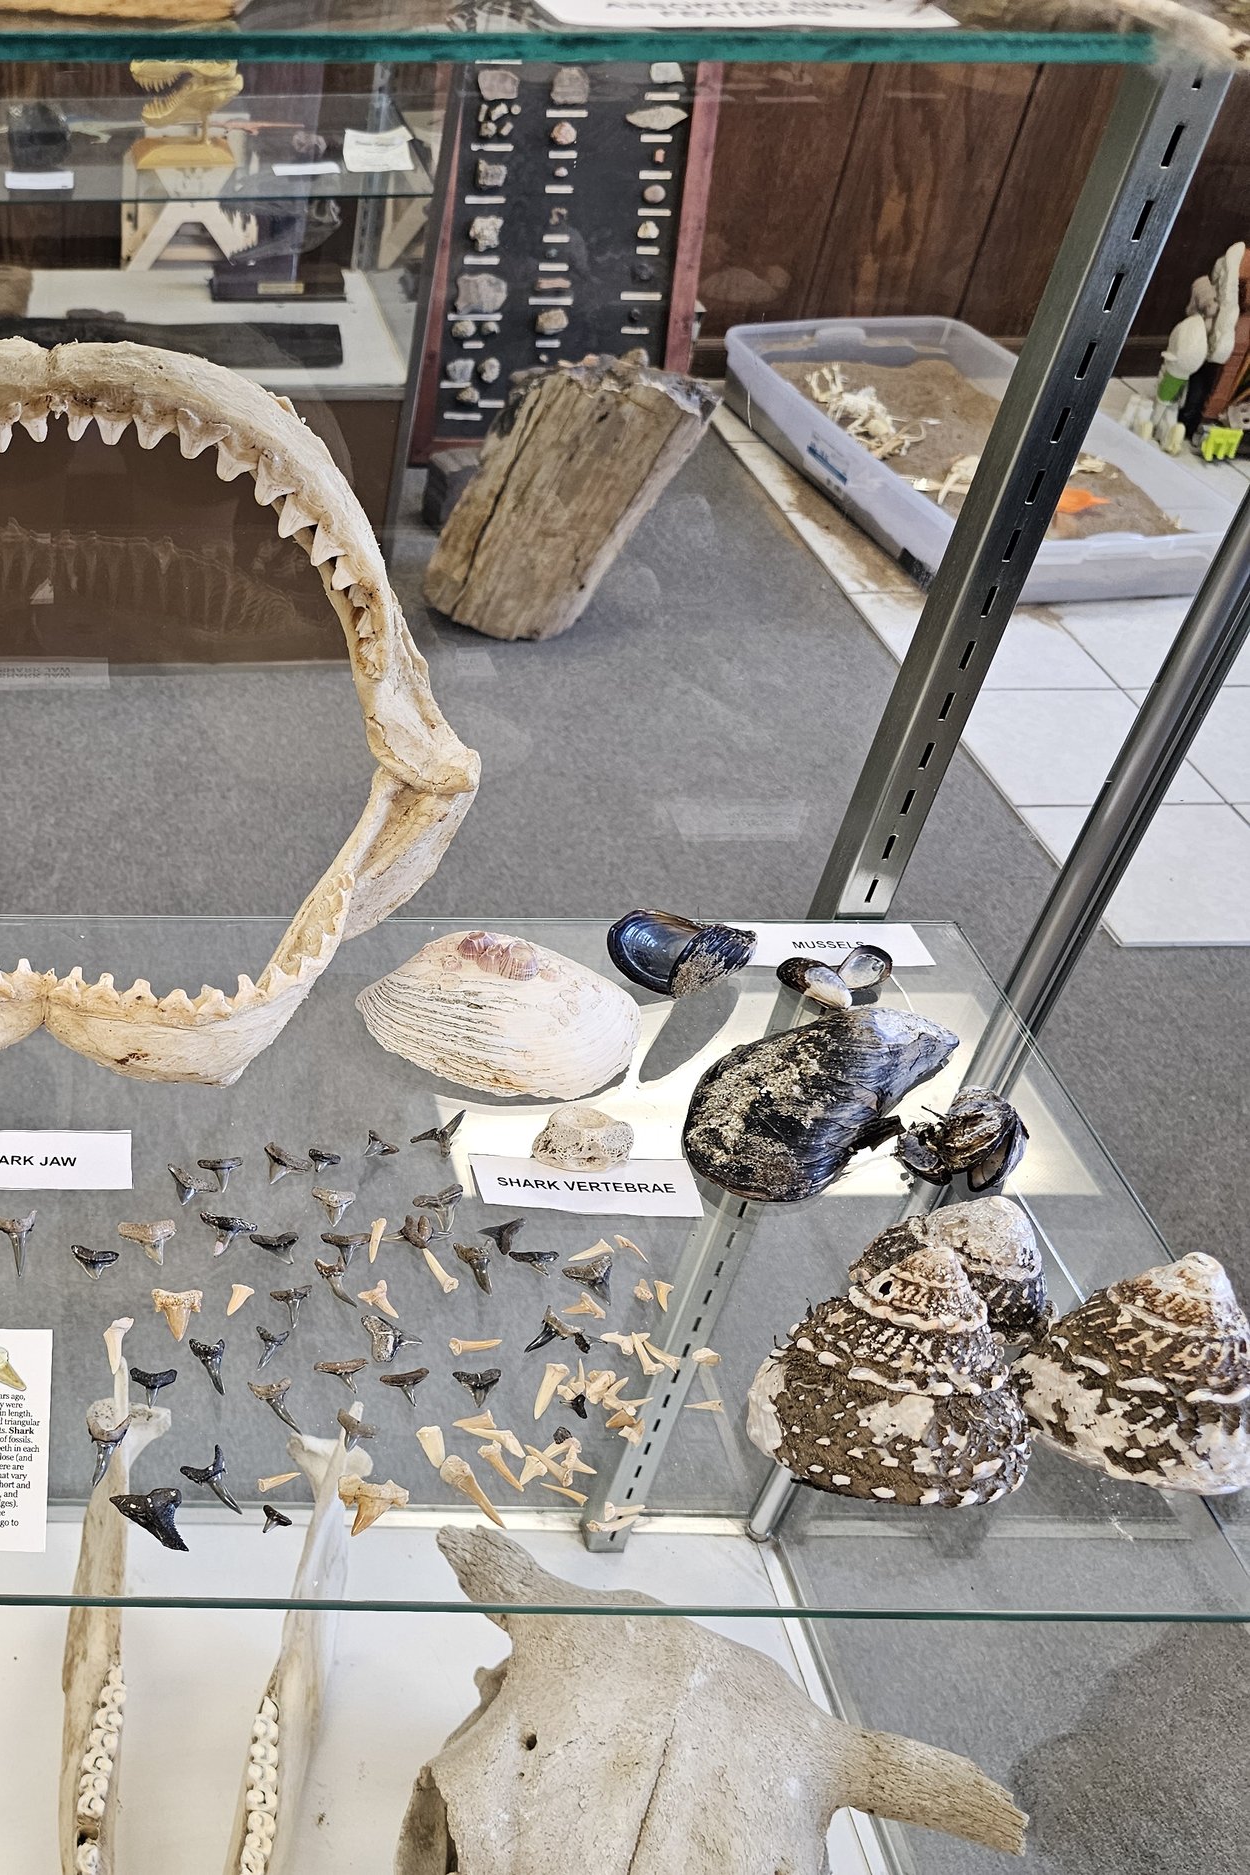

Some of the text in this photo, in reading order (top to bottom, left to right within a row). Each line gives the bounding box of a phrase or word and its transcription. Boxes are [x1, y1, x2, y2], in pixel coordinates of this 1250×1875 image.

[39, 1156, 77, 1168] JAW
[496, 1176, 677, 1194] SHARK VERTEBRAE
[0, 1408, 6, 1416] in
[7, 1408, 33, 1419] length.
[4, 1417, 40, 1428] triangular
[8, 1426, 34, 1434] Shark
[0, 1434, 7, 1442] of
[8, 1434, 33, 1443] fossils.
[13, 1443, 21, 1451] in
[22, 1444, 39, 1452] each
[0, 1452, 14, 1460] lose
[15, 1452, 32, 1463] (and
[10, 1473, 27, 1481] vary
[15, 1480, 30, 1488] and
[3, 1488, 18, 1497] and
[10, 1518, 19, 1526] to
